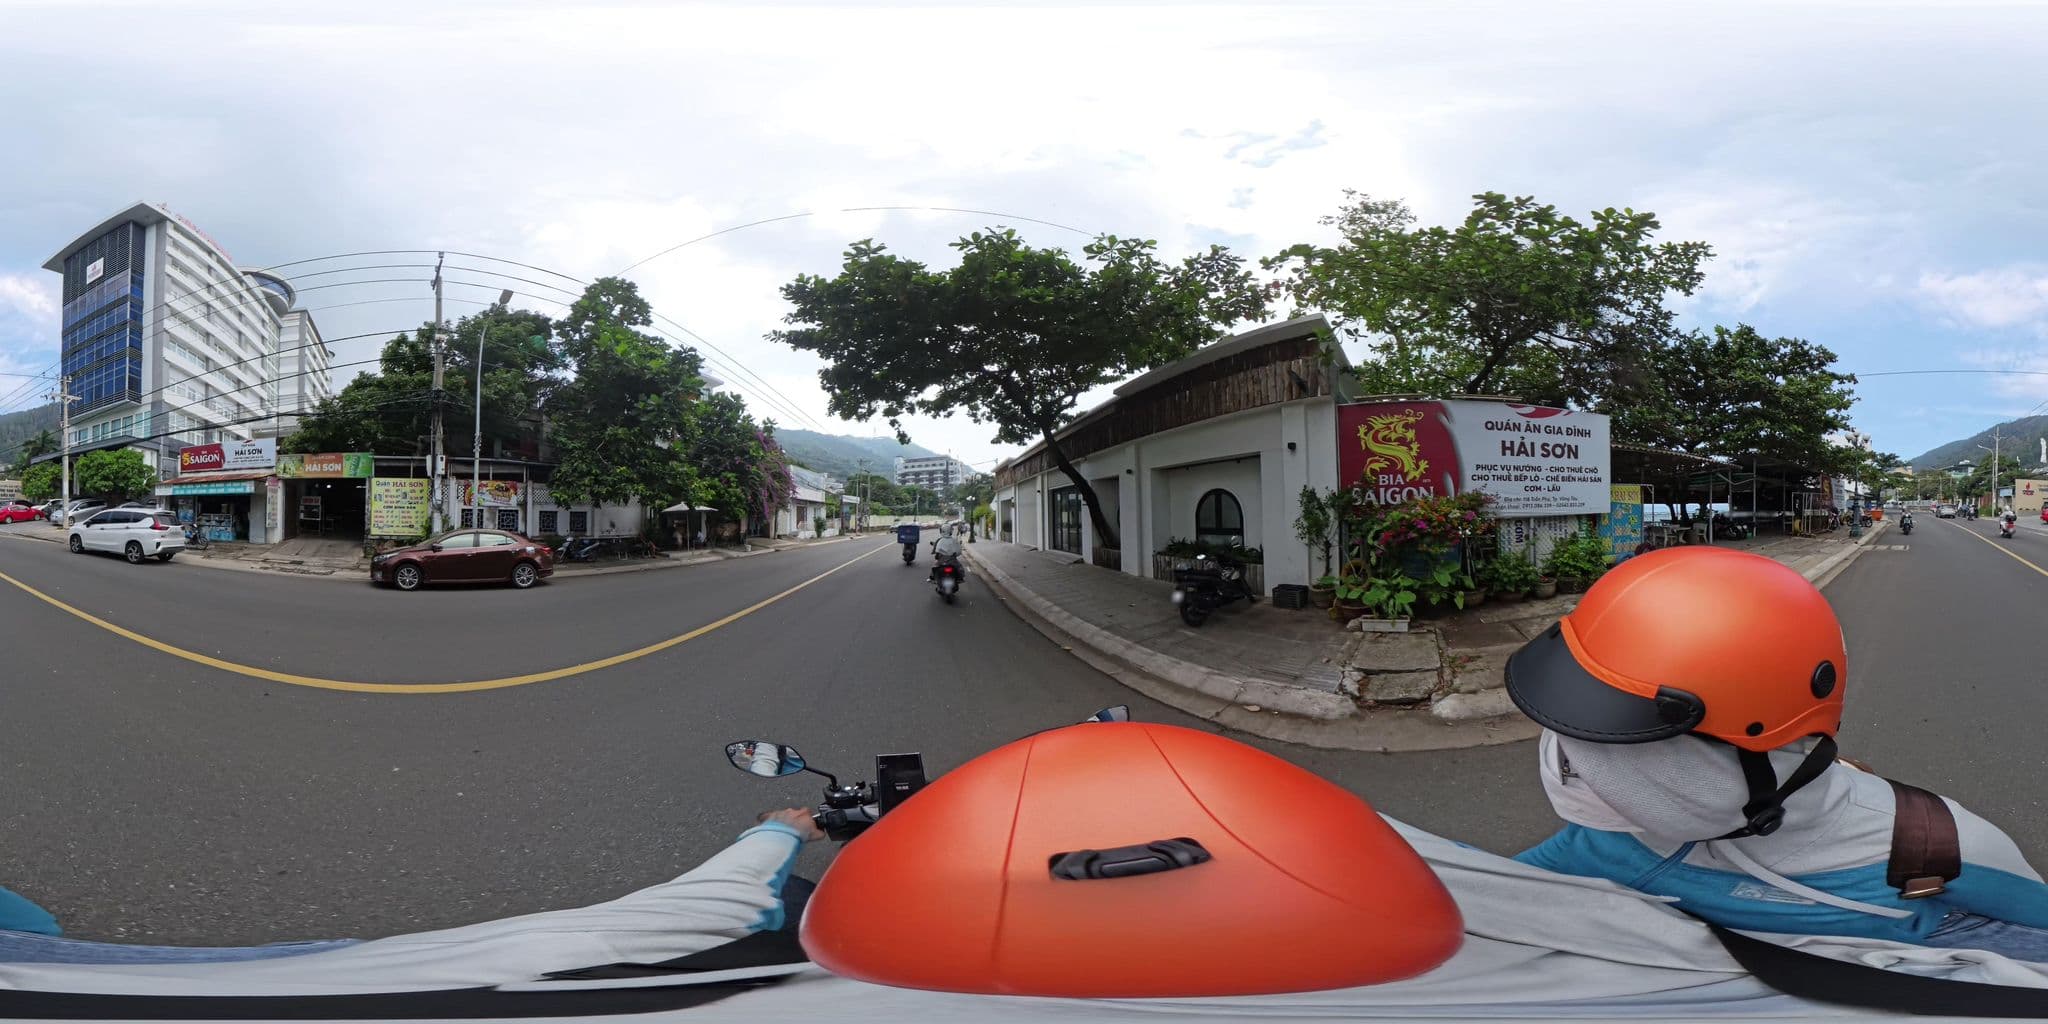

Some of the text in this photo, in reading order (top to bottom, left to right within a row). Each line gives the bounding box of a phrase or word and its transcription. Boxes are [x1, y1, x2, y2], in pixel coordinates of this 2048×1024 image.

[1484, 419, 1591, 438] QUÁN ĂN GIA ĐÌNH
[1501, 436, 1578, 459] HẢI SƠN
[190, 453, 220, 464] SAIGON
[1475, 464, 1498, 473] PHỤC
[1378, 474, 1405, 485] BIA
[1524, 484, 1542, 492] CƠM
